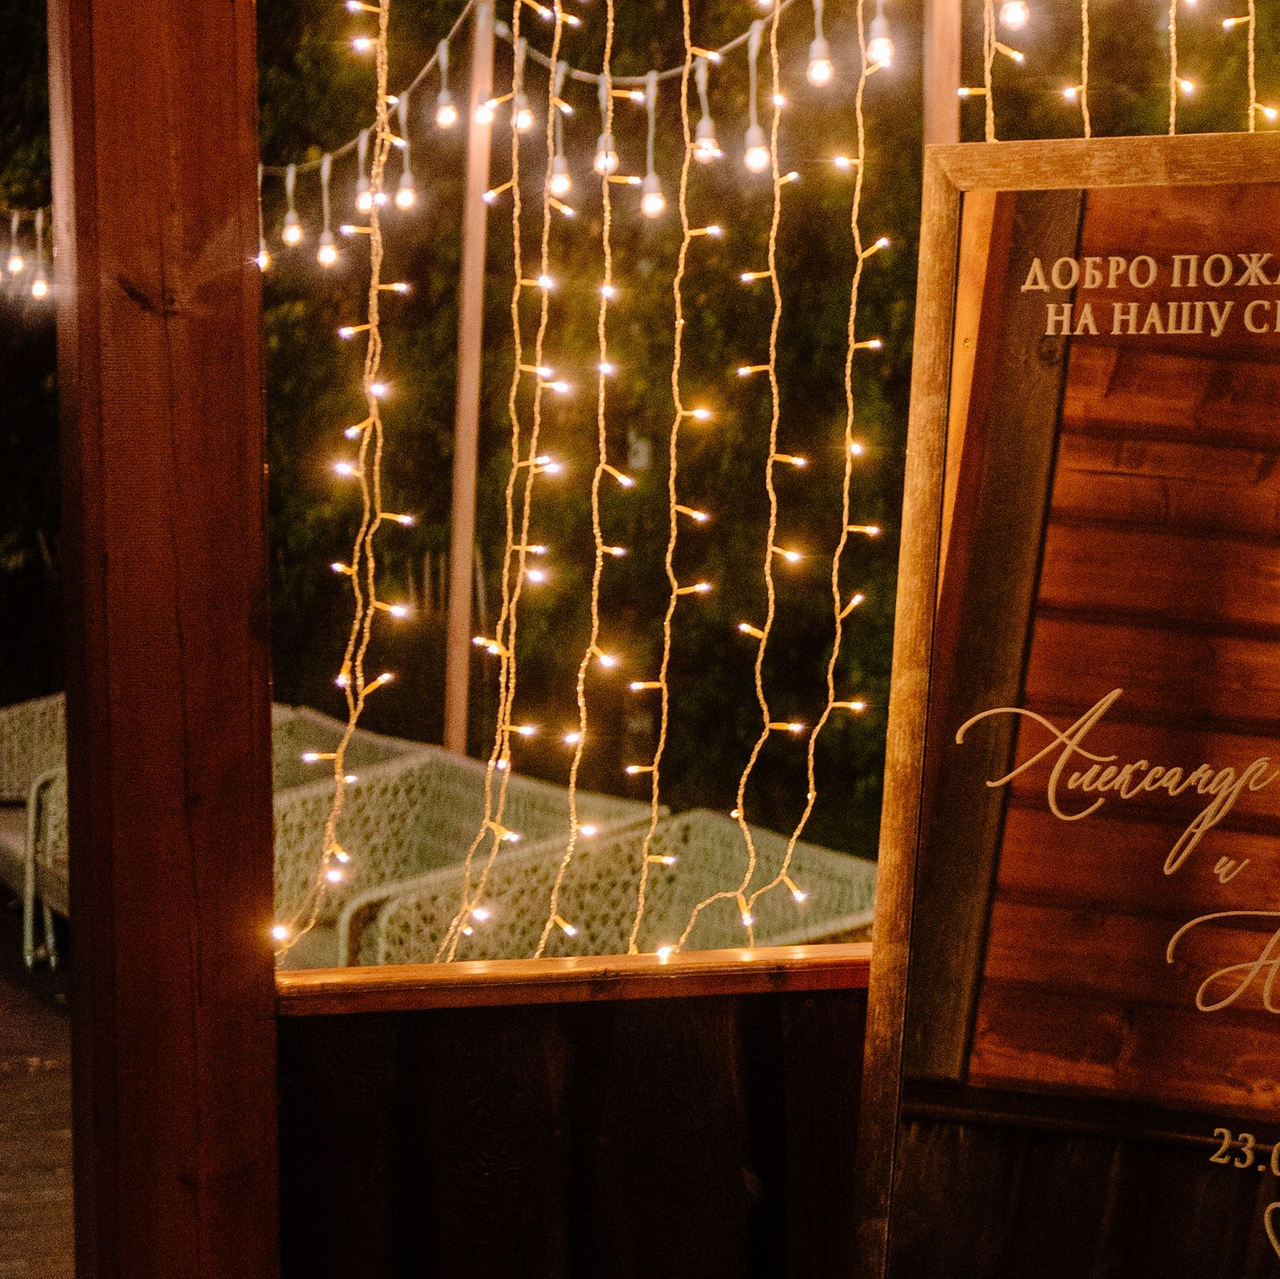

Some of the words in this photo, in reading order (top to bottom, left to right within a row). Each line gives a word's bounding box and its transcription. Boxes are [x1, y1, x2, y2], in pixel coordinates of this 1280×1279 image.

[1020, 255, 1157, 293] ДОБРО
[1045, 303, 1098, 336] НА
[1110, 300, 1235, 337] НАШУ
[956, 688, 1278, 875] Александр
[1214, 854, 1249, 883] и
